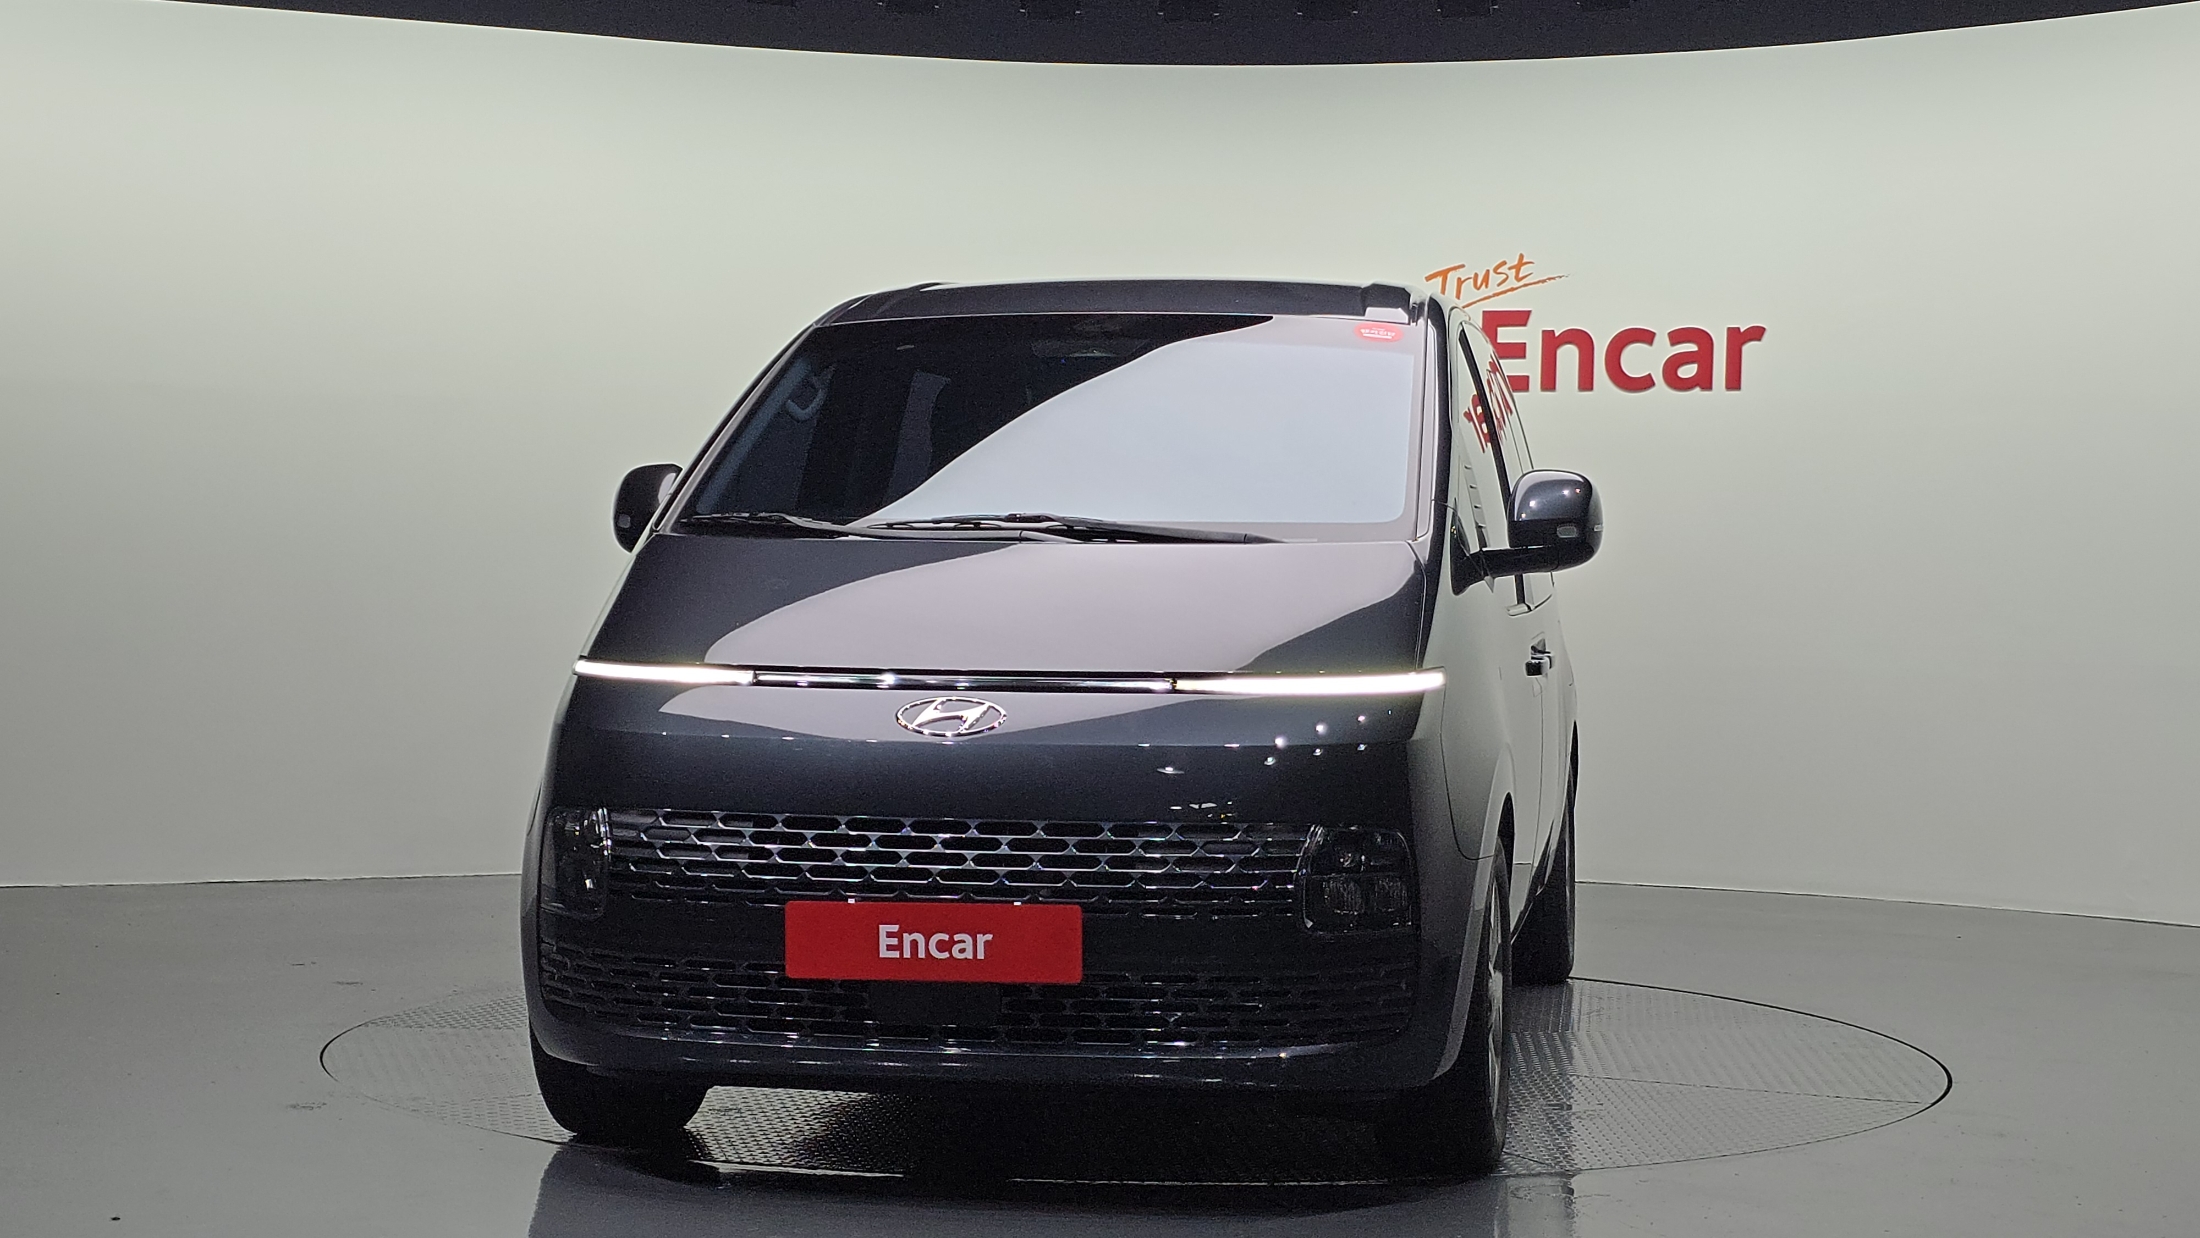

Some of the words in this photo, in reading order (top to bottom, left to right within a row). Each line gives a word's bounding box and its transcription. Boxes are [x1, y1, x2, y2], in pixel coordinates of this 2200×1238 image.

[1424, 252, 1536, 300] Trust
[1481, 309, 1767, 393] Encar
[878, 924, 994, 960] Encar
